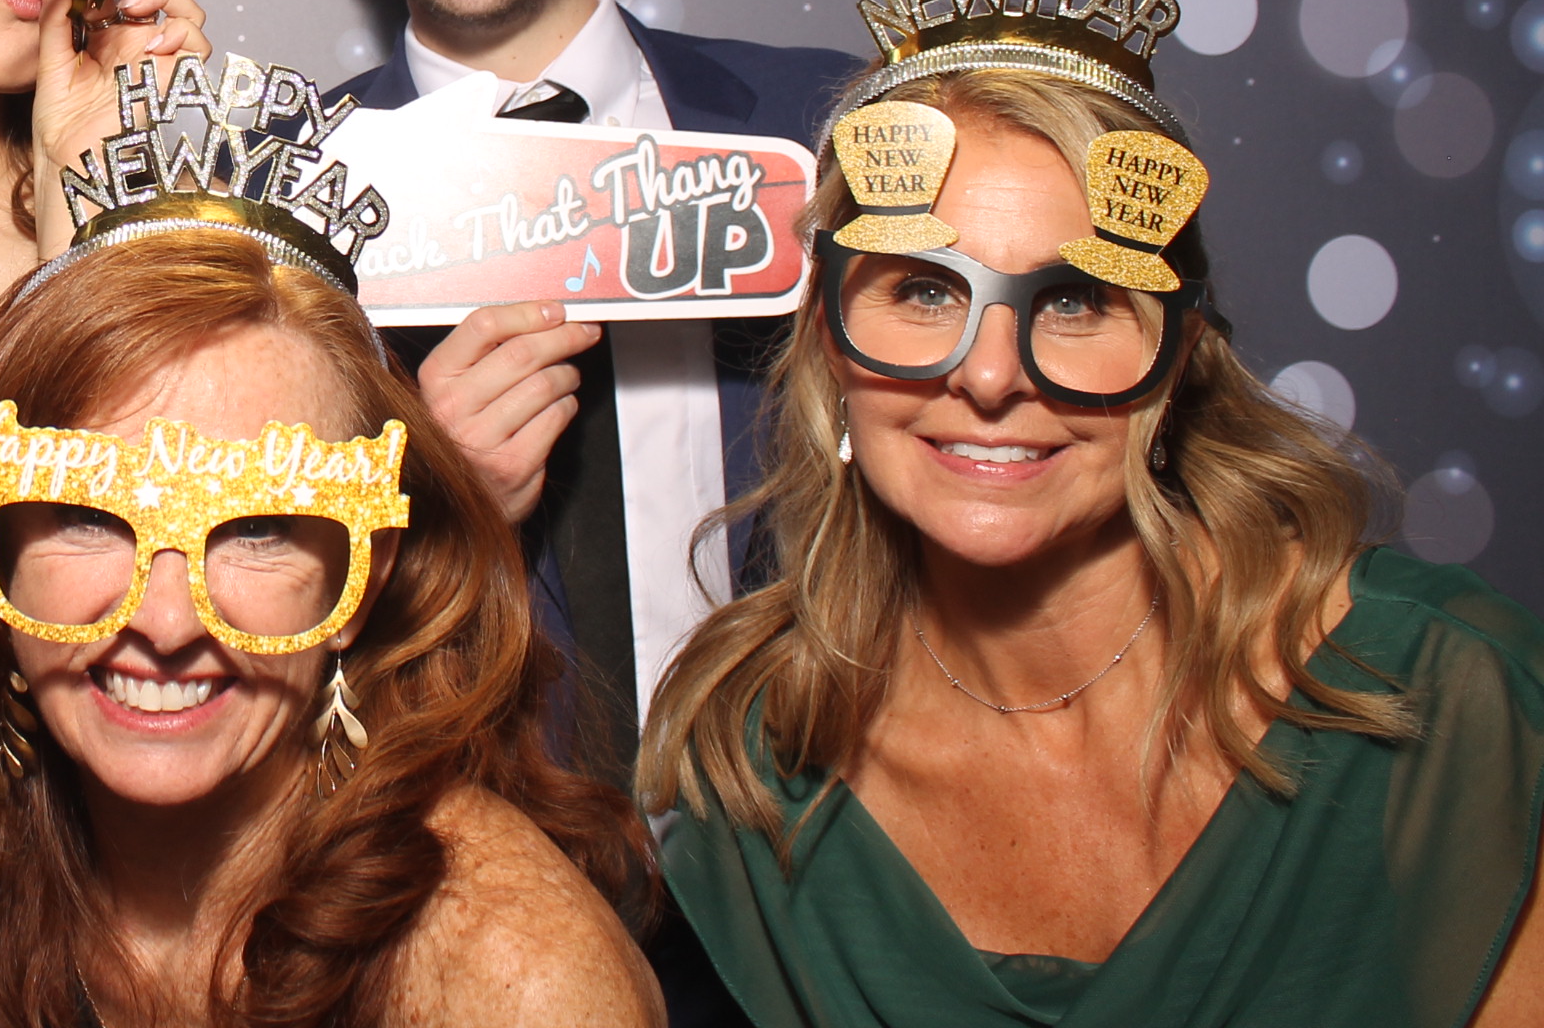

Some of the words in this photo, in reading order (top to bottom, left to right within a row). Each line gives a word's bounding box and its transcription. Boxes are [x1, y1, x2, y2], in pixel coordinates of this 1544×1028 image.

[114, 52, 361, 147] HAPPY
[853, 123, 935, 144] HAPPY
[865, 148, 924, 169] NEW
[1106, 147, 1190, 187] HAPPY
[864, 174, 927, 194] YEAR
[1110, 174, 1172, 207] NEW
[358, 214, 448, 277] ack
[454, 176, 590, 262] That
[592, 135, 763, 224] Thang
[1104, 198, 1165, 234] YEAR
[620, 190, 774, 299] UP
[133, 424, 247, 482] New
[259, 428, 402, 497] Year!
